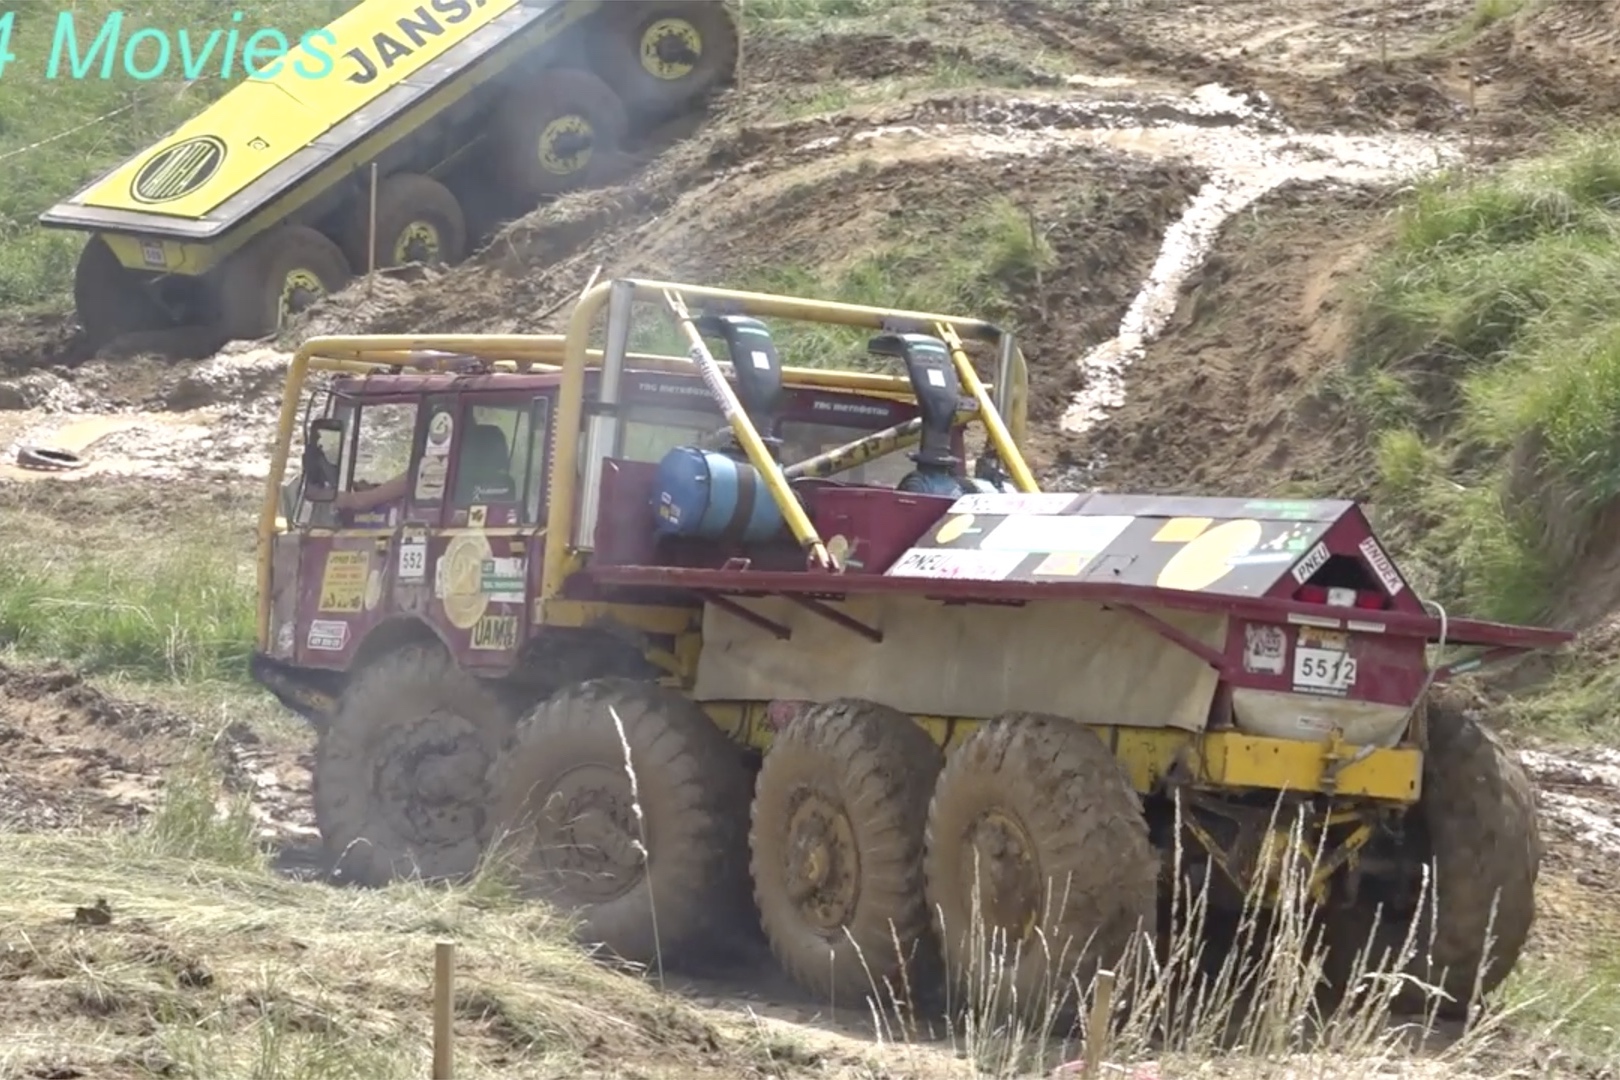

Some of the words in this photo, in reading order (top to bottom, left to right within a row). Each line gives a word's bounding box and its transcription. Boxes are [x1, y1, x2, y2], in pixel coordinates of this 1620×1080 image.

[341, 0, 487, 84] JANS
[403, 552, 423, 569] 552
[1298, 544, 1328, 580] PNEU
[1363, 539, 1400, 590] HNIDEK
[1301, 657, 1355, 681] 5512
